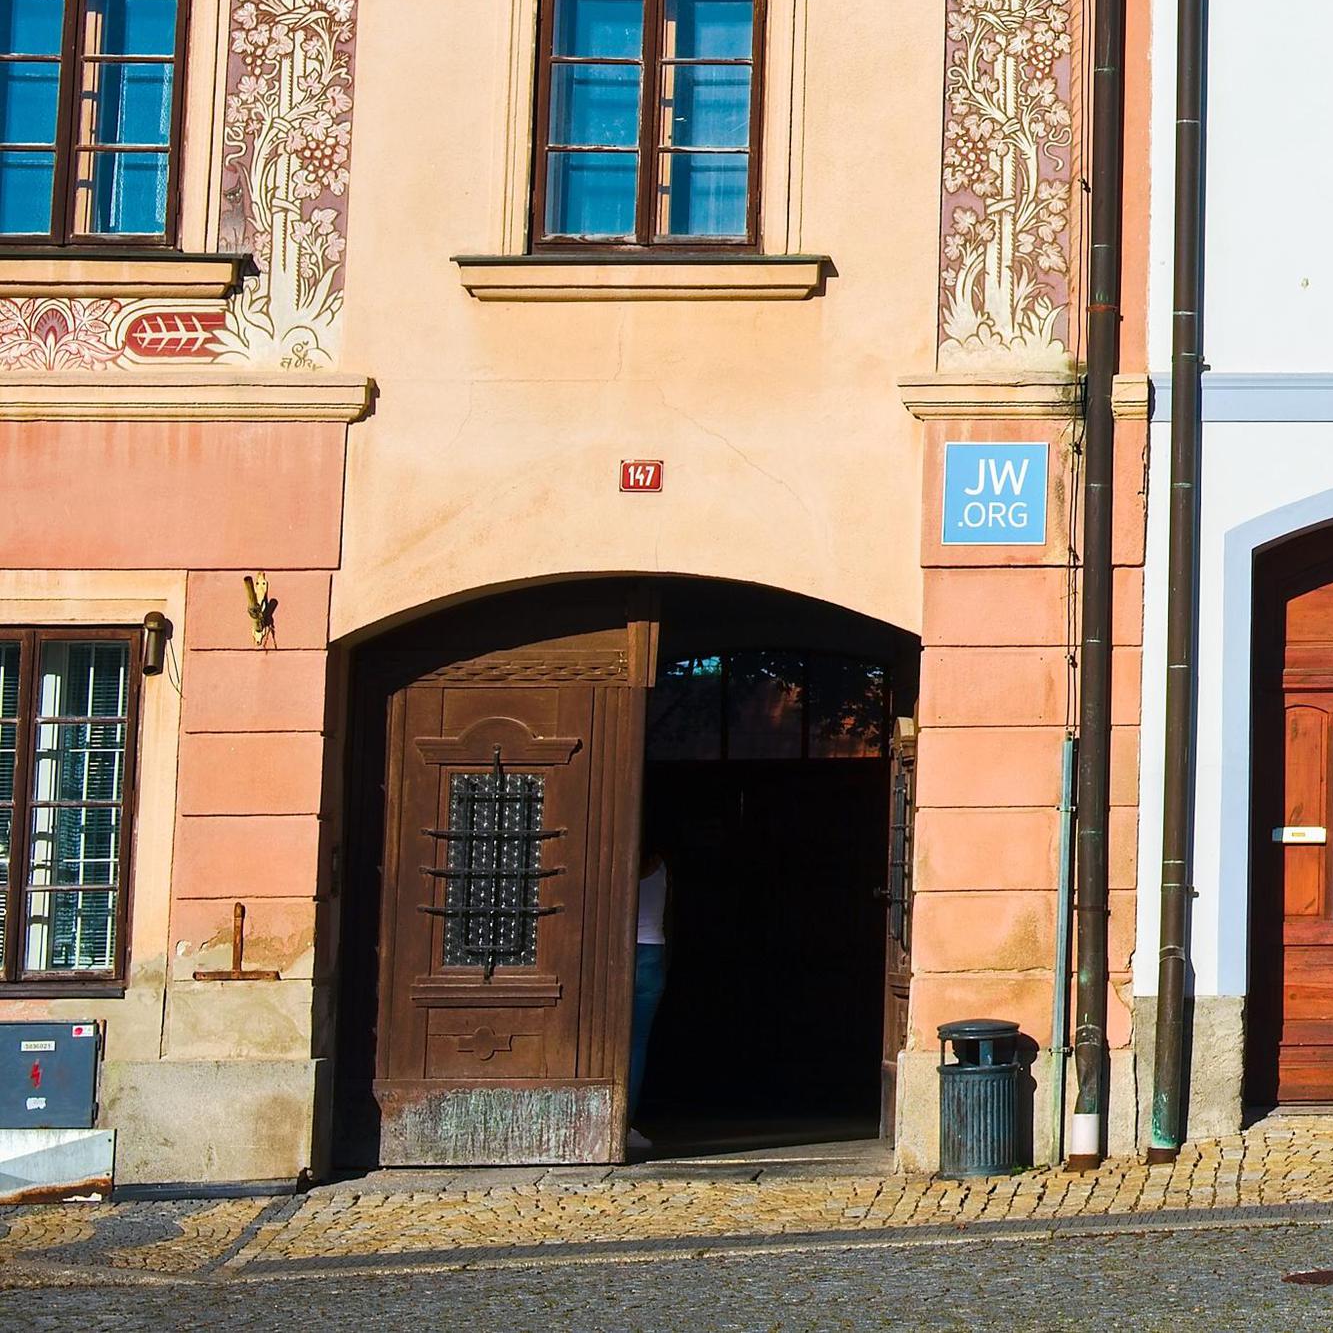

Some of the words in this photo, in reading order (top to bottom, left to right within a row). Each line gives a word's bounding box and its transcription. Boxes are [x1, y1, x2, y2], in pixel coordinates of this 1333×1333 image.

[628, 465, 655, 486] 147
[963, 458, 1030, 496] JW
[958, 501, 1028, 528] .ORG
